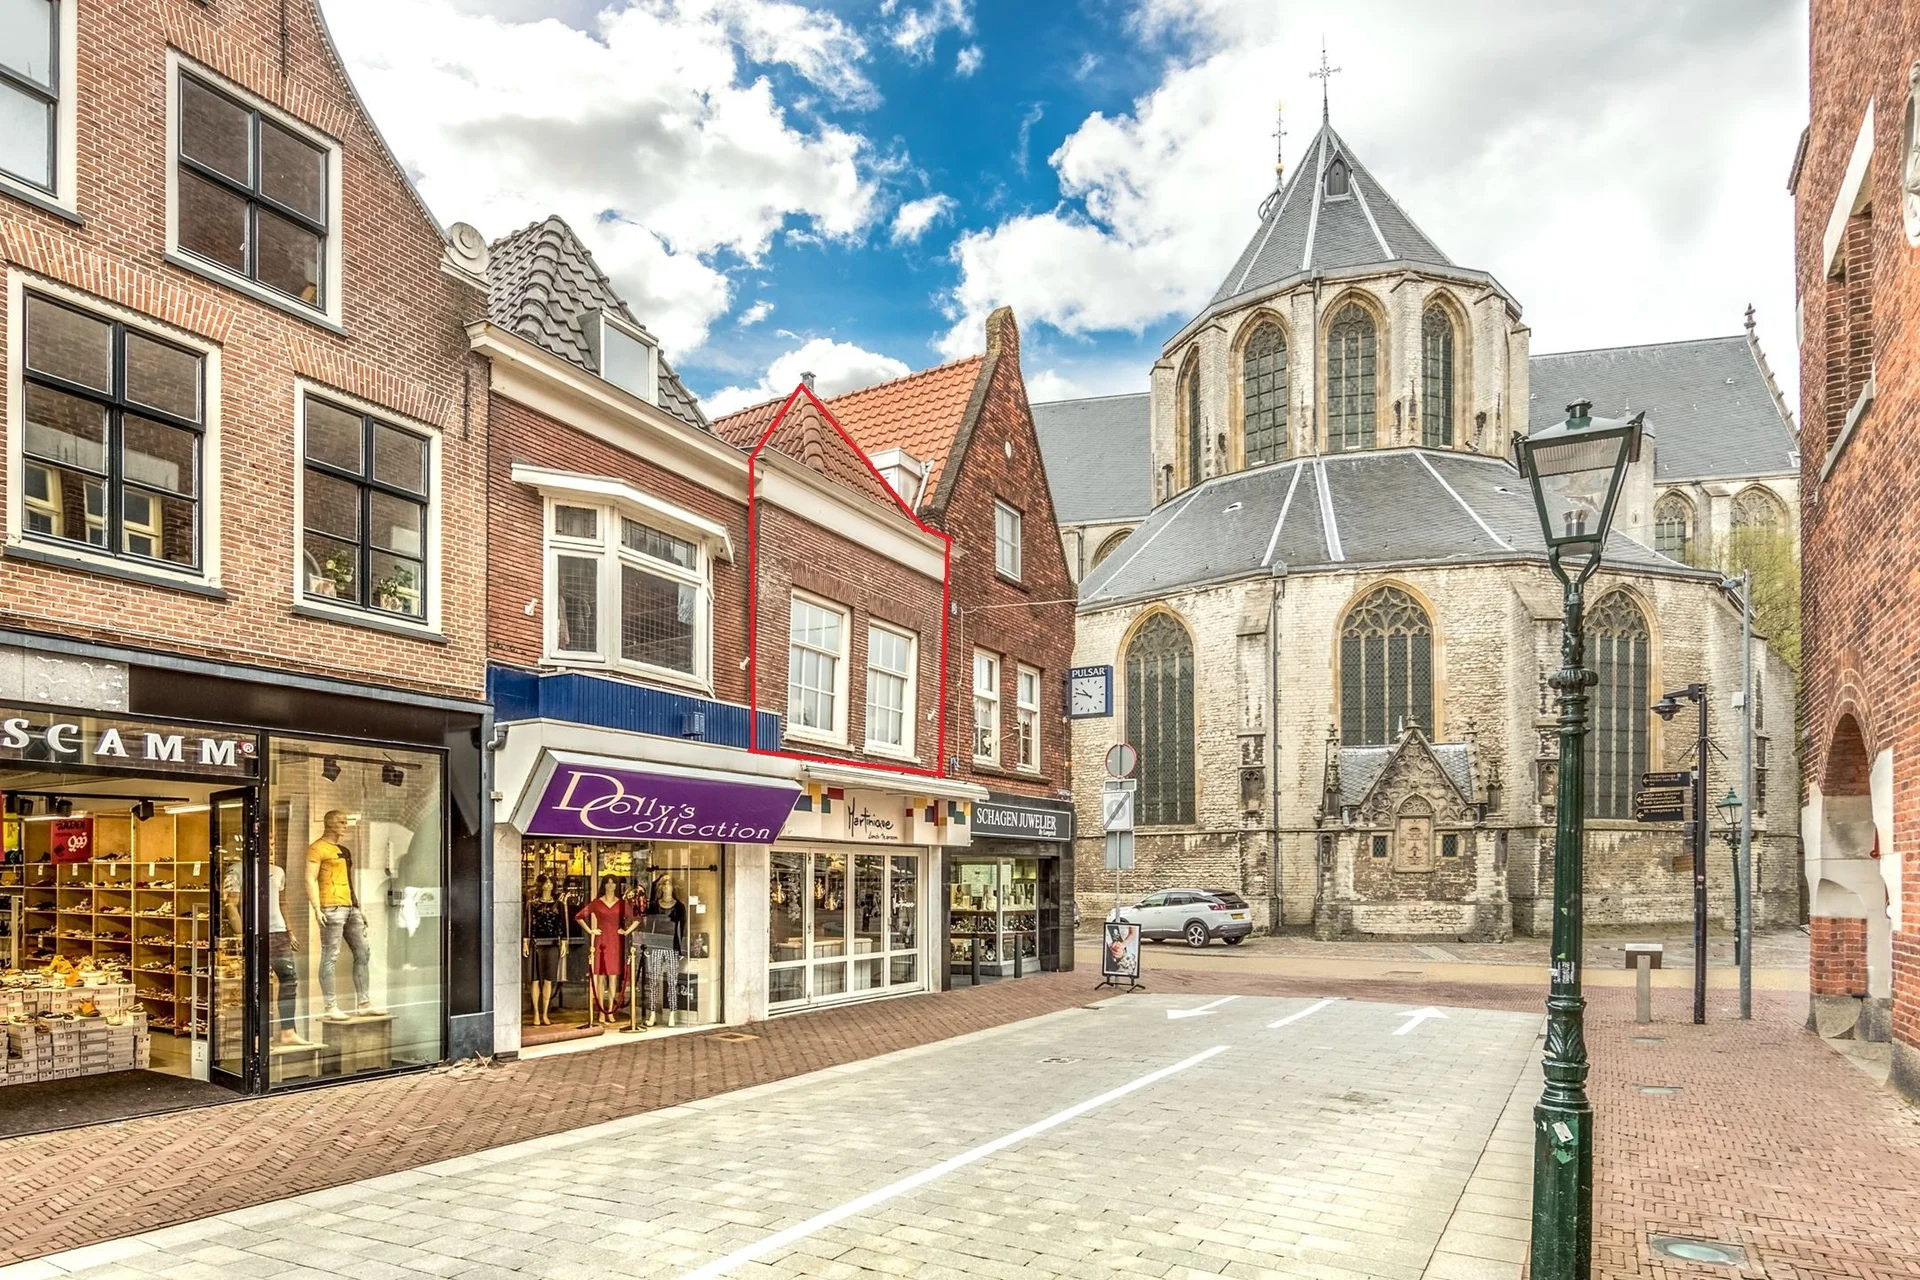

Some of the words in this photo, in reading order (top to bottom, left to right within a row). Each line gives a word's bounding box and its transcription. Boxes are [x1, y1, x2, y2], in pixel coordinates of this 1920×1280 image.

[1072, 667, 1105, 678] PULSAR
[552, 770, 696, 822] Dolly's
[580, 794, 771, 840] Collection
[848, 796, 894, 838] Martinique
[976, 807, 1018, 827] SCHAGEN
[1019, 812, 1057, 831] JUWELIER
